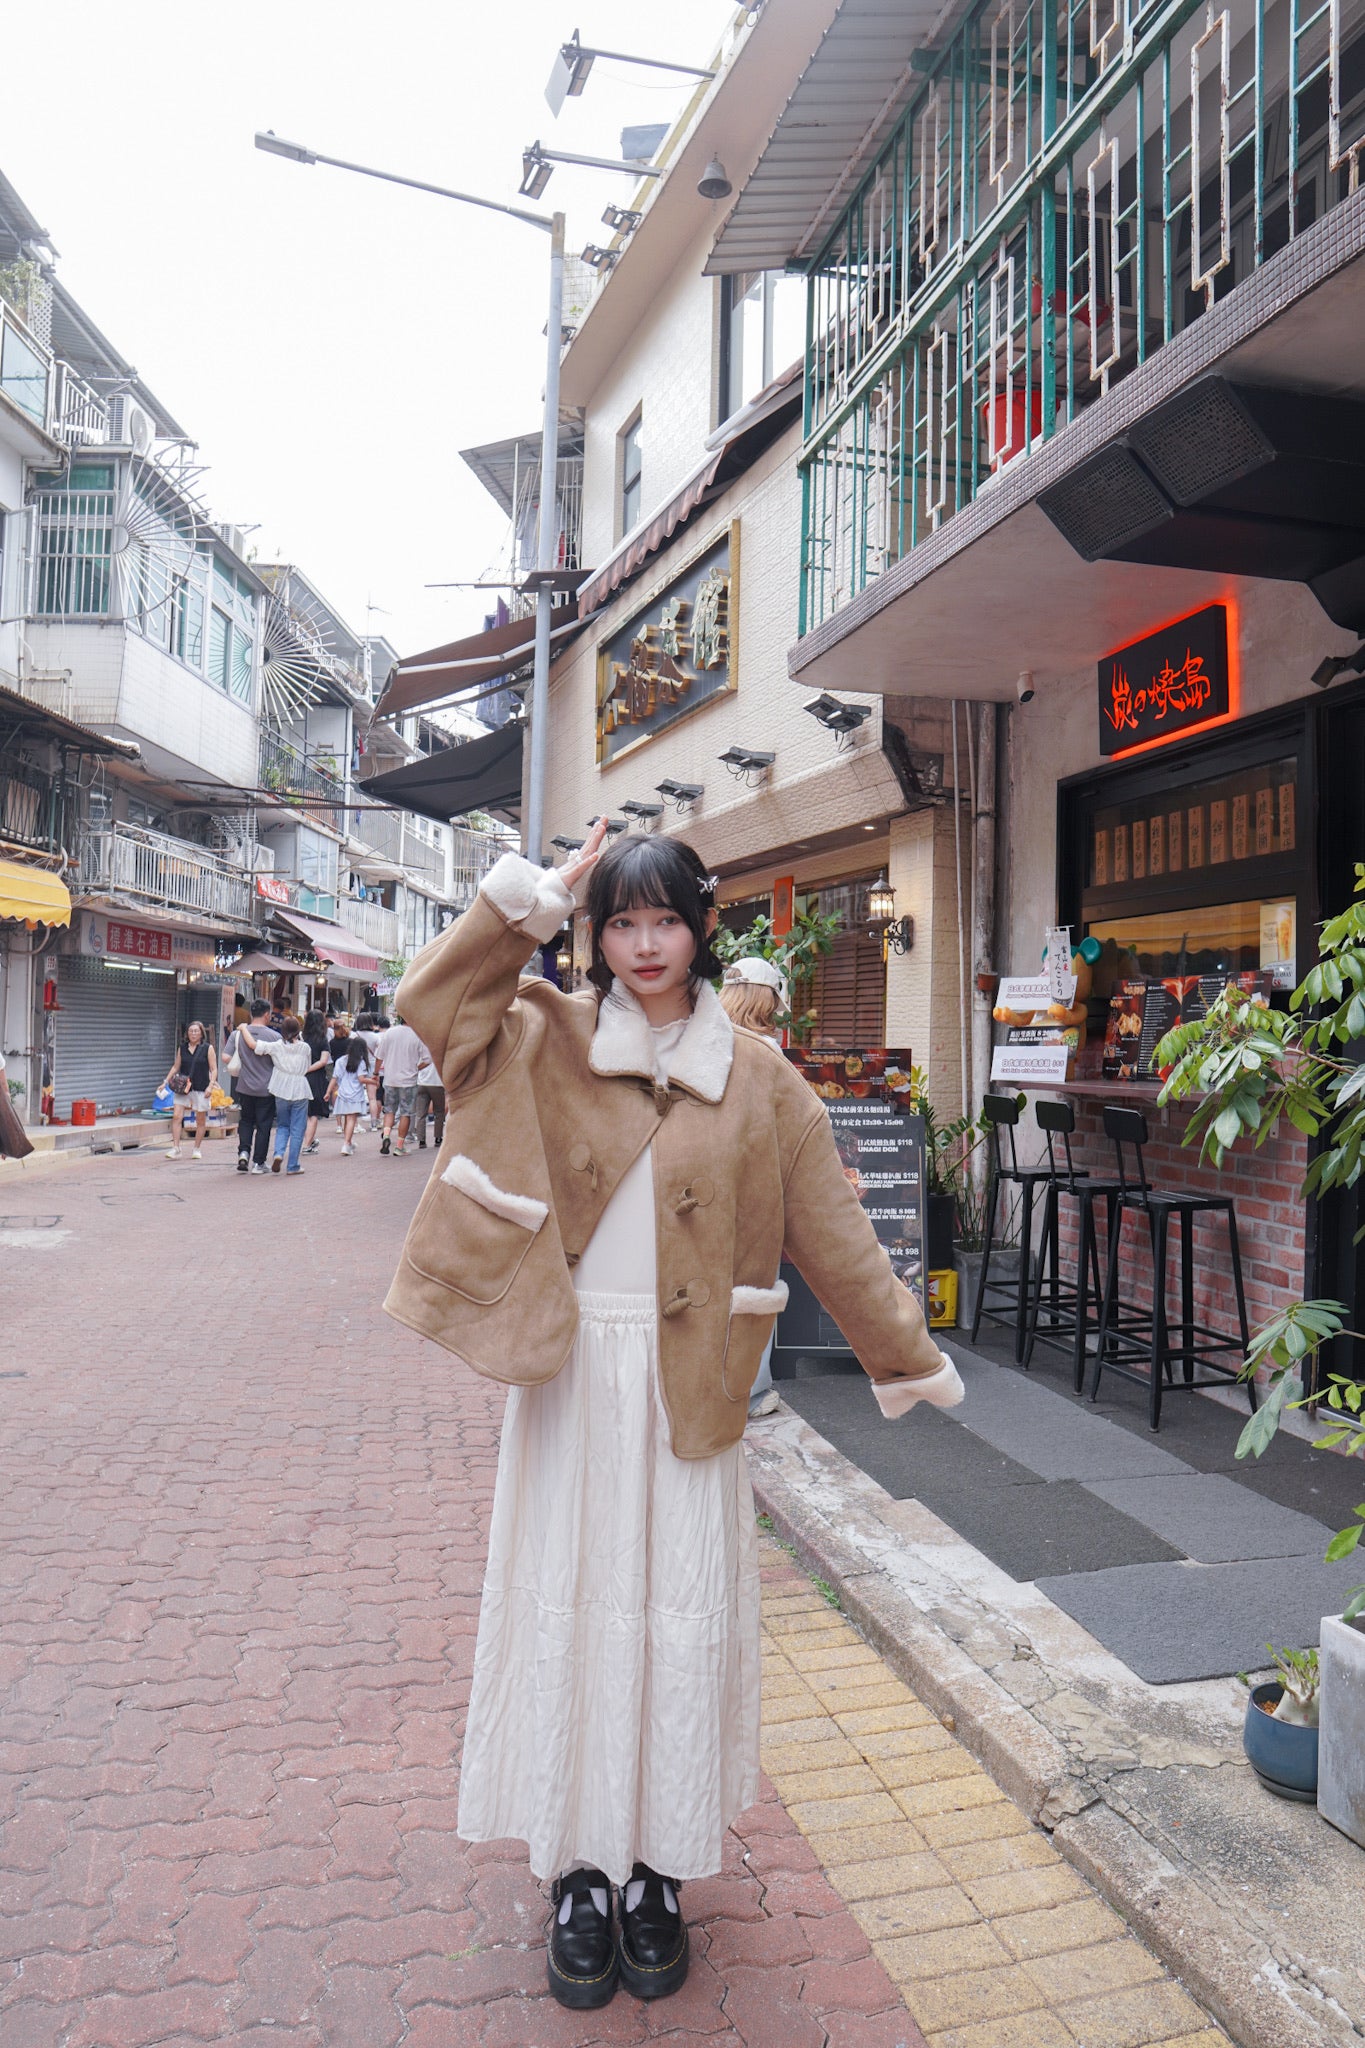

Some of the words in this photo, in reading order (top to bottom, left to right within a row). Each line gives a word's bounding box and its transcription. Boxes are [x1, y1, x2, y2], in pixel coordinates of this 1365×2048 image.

[110, 925, 171, 957] 標準石油氣
[1054, 954, 1063, 996] てんこもり
[897, 1138, 913, 1146] $118
[903, 1172, 919, 1180] $118
[905, 1247, 919, 1256] $98
